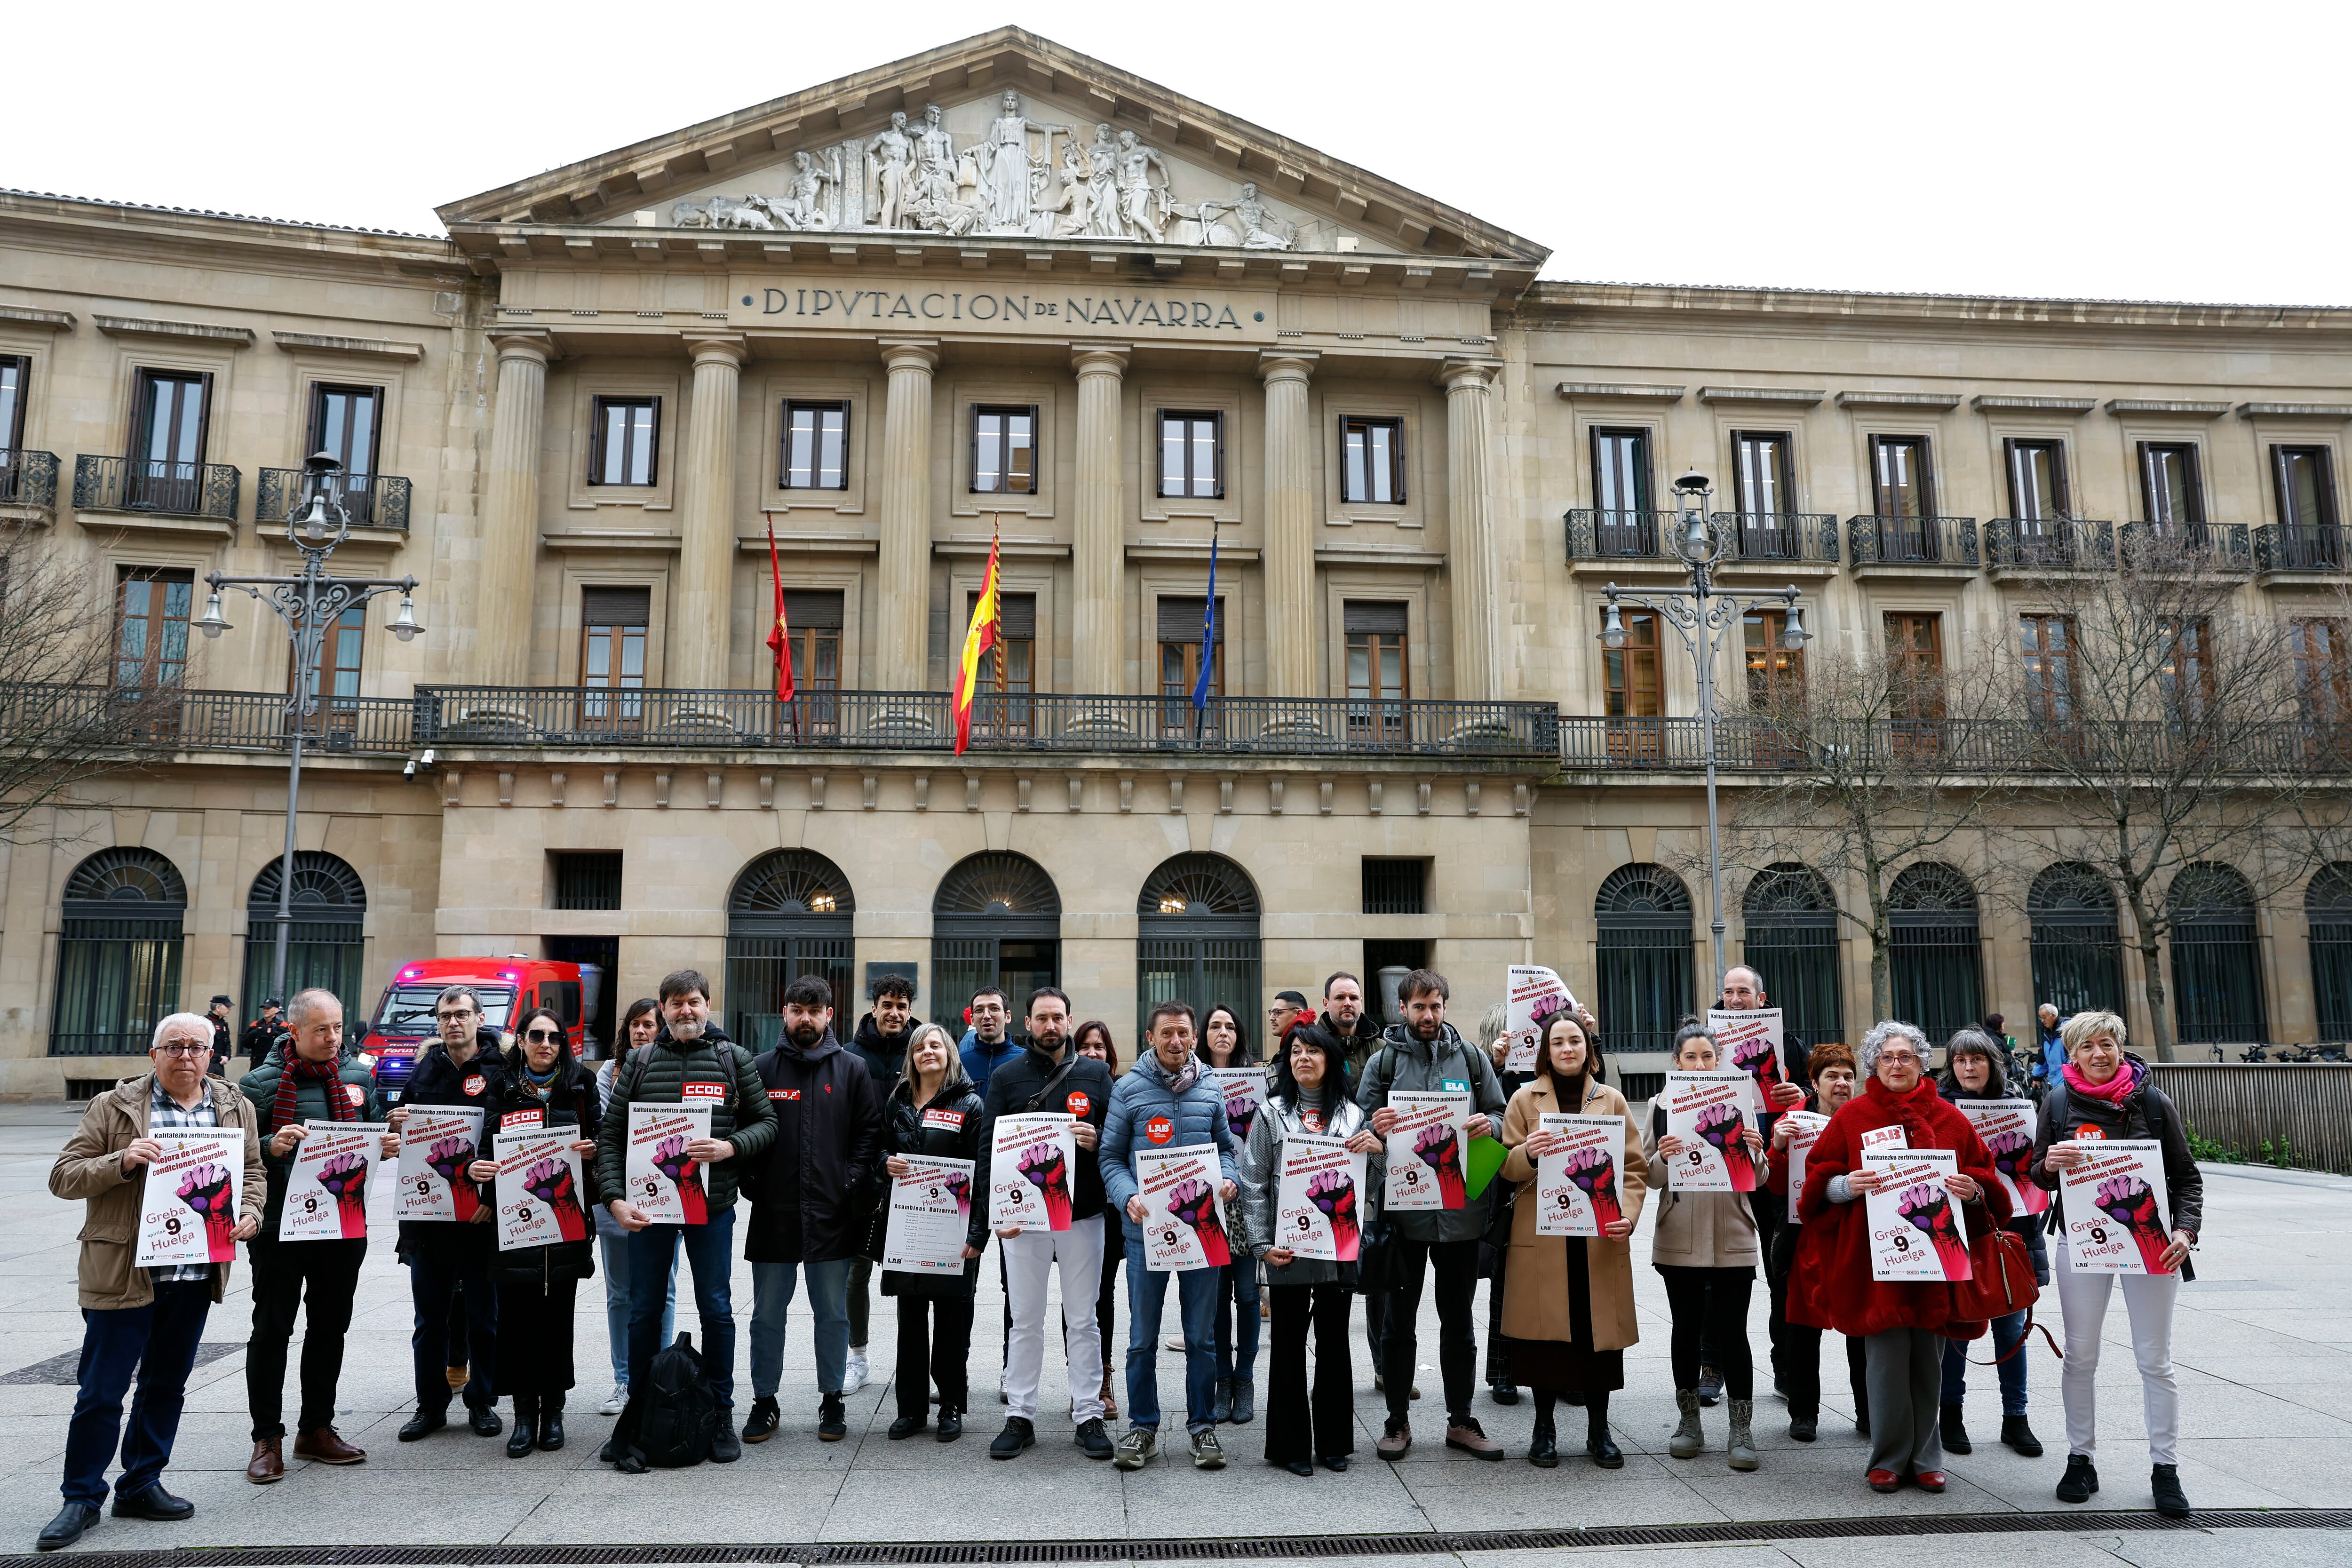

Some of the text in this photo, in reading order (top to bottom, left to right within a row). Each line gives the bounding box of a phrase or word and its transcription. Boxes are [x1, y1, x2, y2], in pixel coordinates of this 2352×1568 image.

[763, 288, 1242, 328] DIPVTACION DE NAVARRA
[1512, 986, 1531, 995] Mejora
[1511, 1027, 1538, 1039] Greba
[1739, 1021, 1762, 1032] nuestras
[1744, 1027, 1769, 1039] laborales
[1524, 1035, 1535, 1048] 9
[466, 1077, 483, 1087] UGT
[1224, 1080, 1247, 1091] nuestras
[1446, 1082, 1465, 1091] ELA
[347, 1087, 360, 1096] UGT
[685, 1085, 723, 1095] CCOO
[1229, 1086, 1254, 1098] laborales
[504, 1111, 540, 1125] CCOO
[927, 1111, 961, 1122] CCOO
[1994, 1113, 2018, 1124] nuestras
[1795, 1132, 1815, 1141] Mejora
[191, 1142, 220, 1154] nuestras
[1543, 1136, 1608, 1156] condiciones laborales
[151, 1150, 227, 1176] condiciones laborales
[1689, 1151, 1702, 1166] 9
[2066, 1165, 2091, 1176] Mejora
[2101, 1154, 2133, 1167] nuestras
[1391, 1162, 1422, 1175] Greba
[1679, 1164, 1716, 1179] Huelga
[1903, 1163, 1931, 1176] nuestras
[2066, 1162, 2143, 1186] condiciones laborales
[402, 1171, 434, 1185] Greba
[631, 1173, 660, 1186] Greba
[898, 1173, 946, 1187] condiciones laborales
[1406, 1171, 1418, 1185] 9
[1871, 1171, 1940, 1195] condiciones laborales
[417, 1181, 430, 1195] 9
[645, 1183, 658, 1197] 9
[920, 1182, 941, 1190] Greba
[930, 1188, 938, 1198] 9
[994, 1180, 1026, 1193] Greba
[1396, 1183, 1430, 1198] Huelga
[1542, 1185, 1573, 1198] Greba
[290, 1190, 323, 1202] Greba
[406, 1194, 442, 1208] Huelga
[636, 1196, 670, 1210] Huelga
[922, 1196, 947, 1206] Huelga
[1010, 1189, 1023, 1204] 9
[1557, 1194, 1570, 1210] 9
[306, 1198, 318, 1213] 9
[501, 1198, 534, 1214] Greba
[1000, 1203, 1035, 1217] Huelga
[1282, 1206, 1314, 1218] Greba
[146, 1208, 186, 1223] Greba
[293, 1211, 328, 1227] Huelga
[518, 1208, 532, 1222] 9
[1548, 1208, 1583, 1223] Huelga
[166, 1218, 181, 1235] 9
[509, 1218, 546, 1237] Huelga
[1146, 1221, 1179, 1236] Greba
[1298, 1216, 1310, 1231] 9
[2071, 1218, 2109, 1232] Greba
[1163, 1231, 1177, 1246] 9
[1287, 1230, 1322, 1243] Huelga
[1875, 1226, 1911, 1240] Greba
[2090, 1228, 2107, 1244] 9
[152, 1233, 195, 1251] Huelga
[1893, 1236, 1909, 1252] 9
[1155, 1243, 1191, 1259] Huelga
[1884, 1250, 1925, 1266] Huelga
[2082, 1243, 2124, 1259] Huelga
